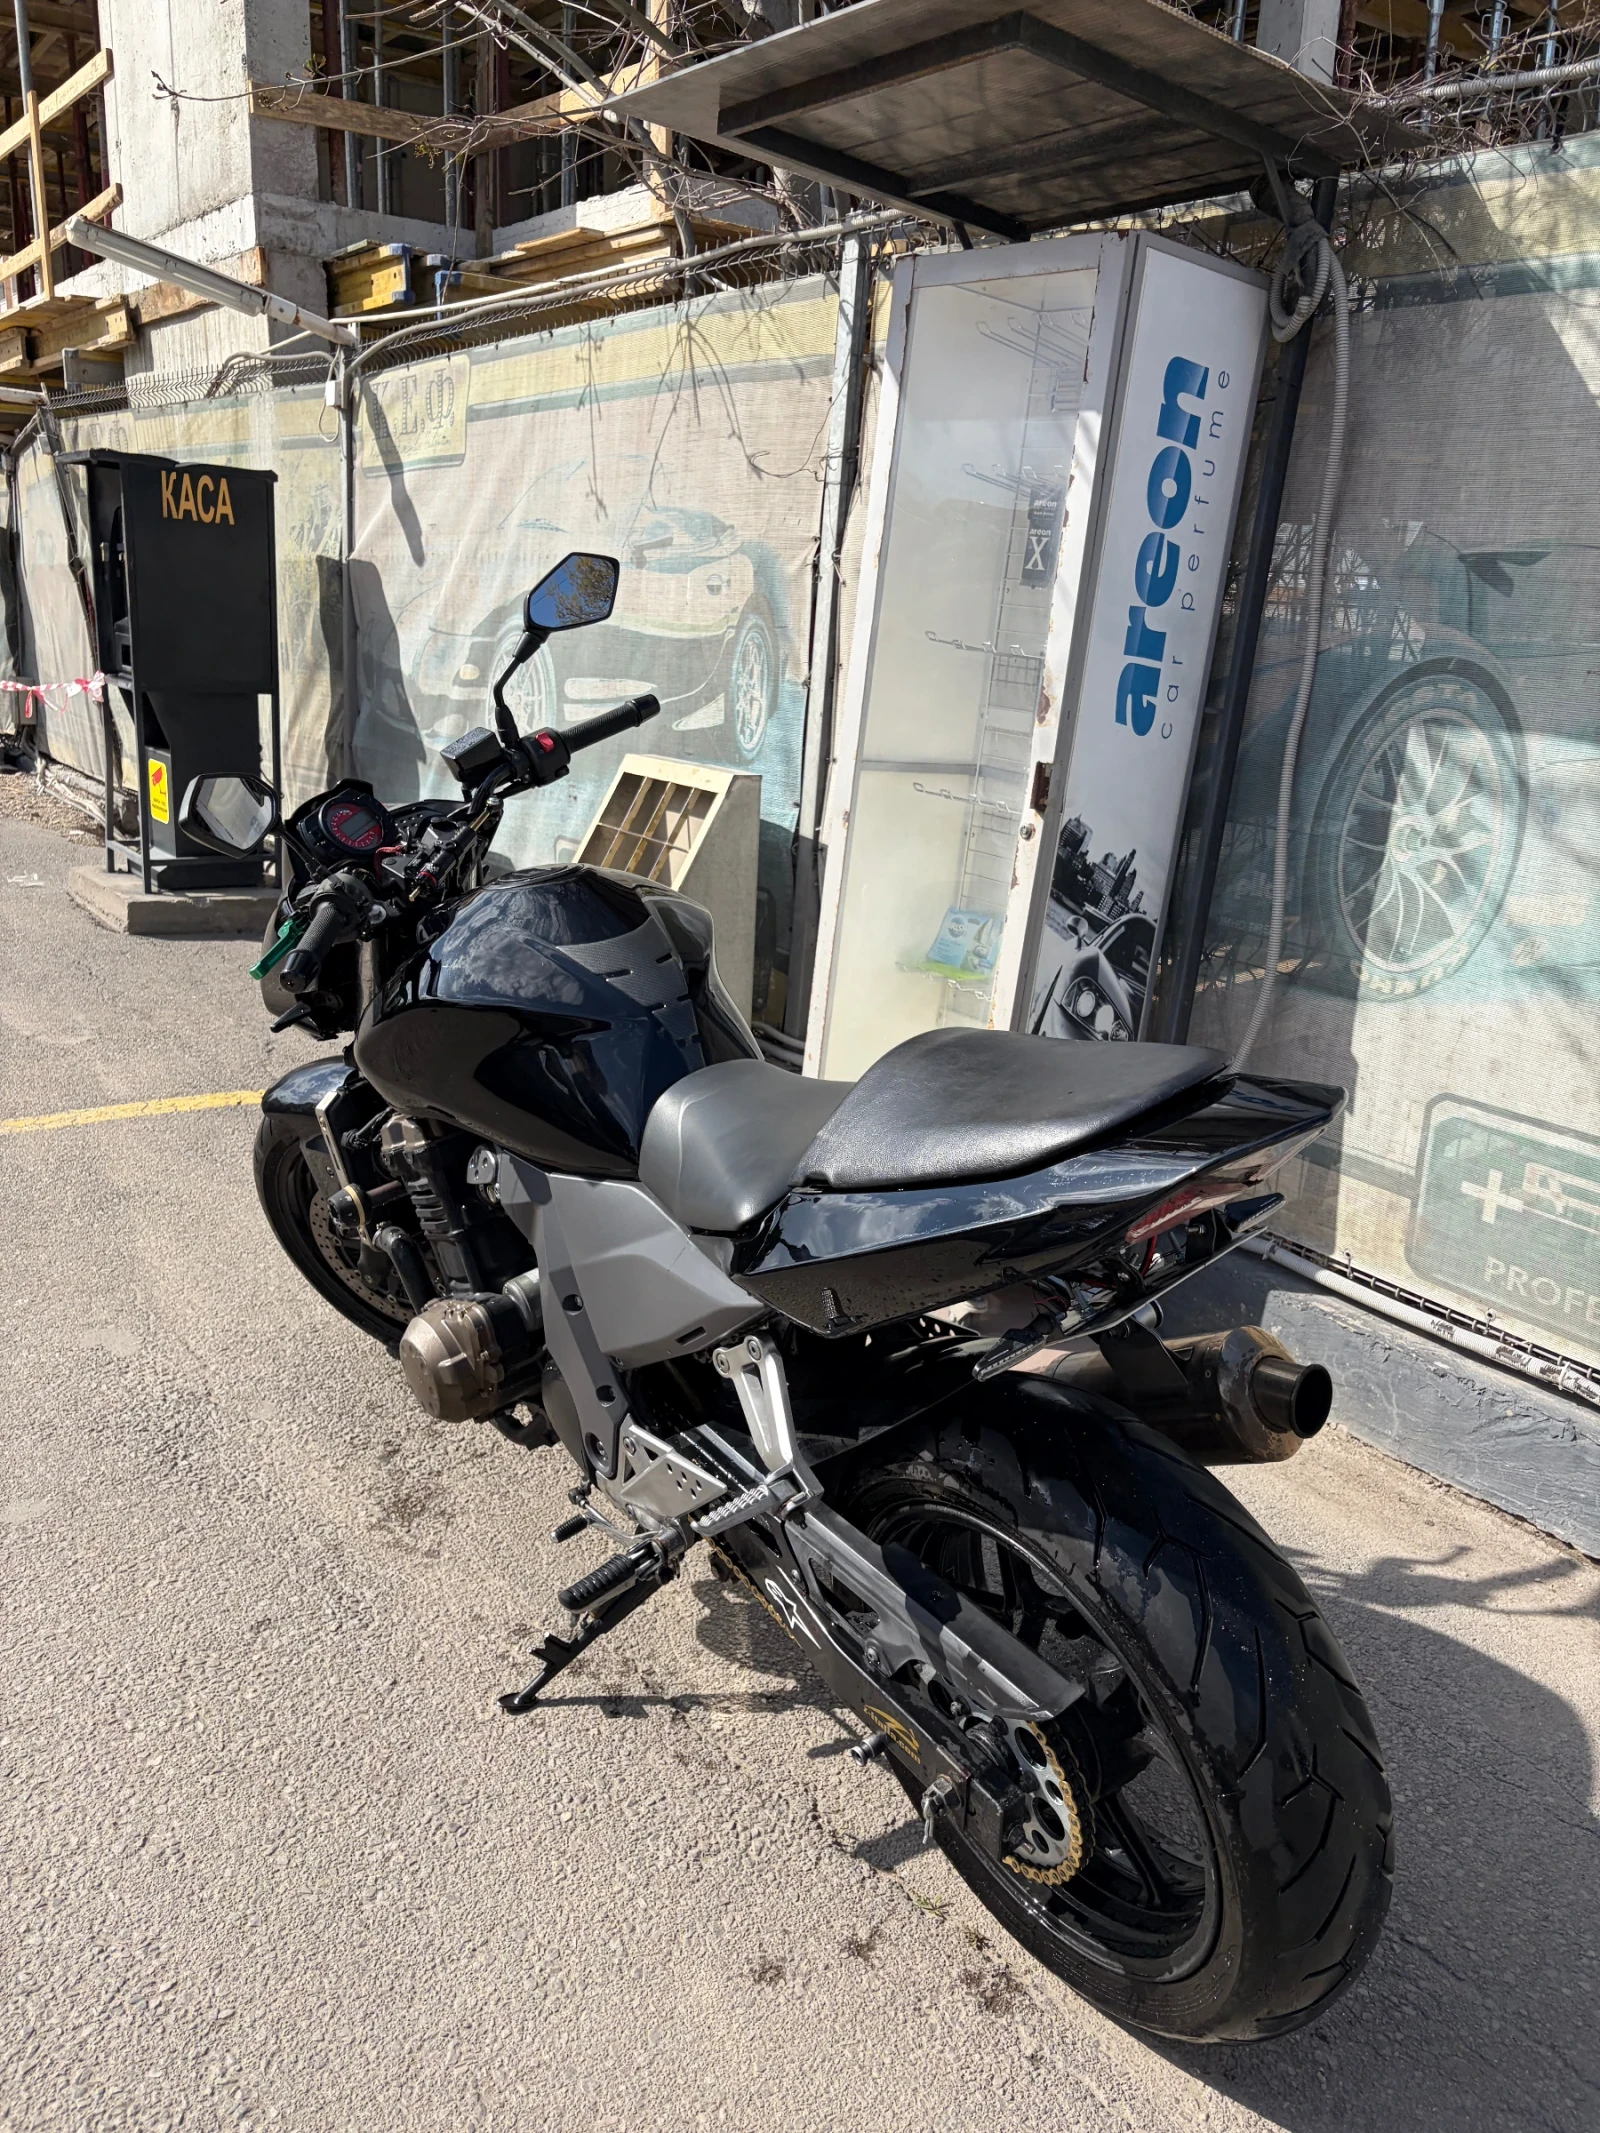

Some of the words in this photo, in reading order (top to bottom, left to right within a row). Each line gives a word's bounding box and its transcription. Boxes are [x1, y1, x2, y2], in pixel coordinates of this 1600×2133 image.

[161, 470, 235, 526] КАСА
[1033, 499, 1057, 508] areon
[1024, 536, 1050, 571] X
[1029, 527, 1052, 536] areon
[1115, 356, 1209, 737] areon
[1161, 655, 1183, 740] car
[1181, 370, 1230, 611] perfume
